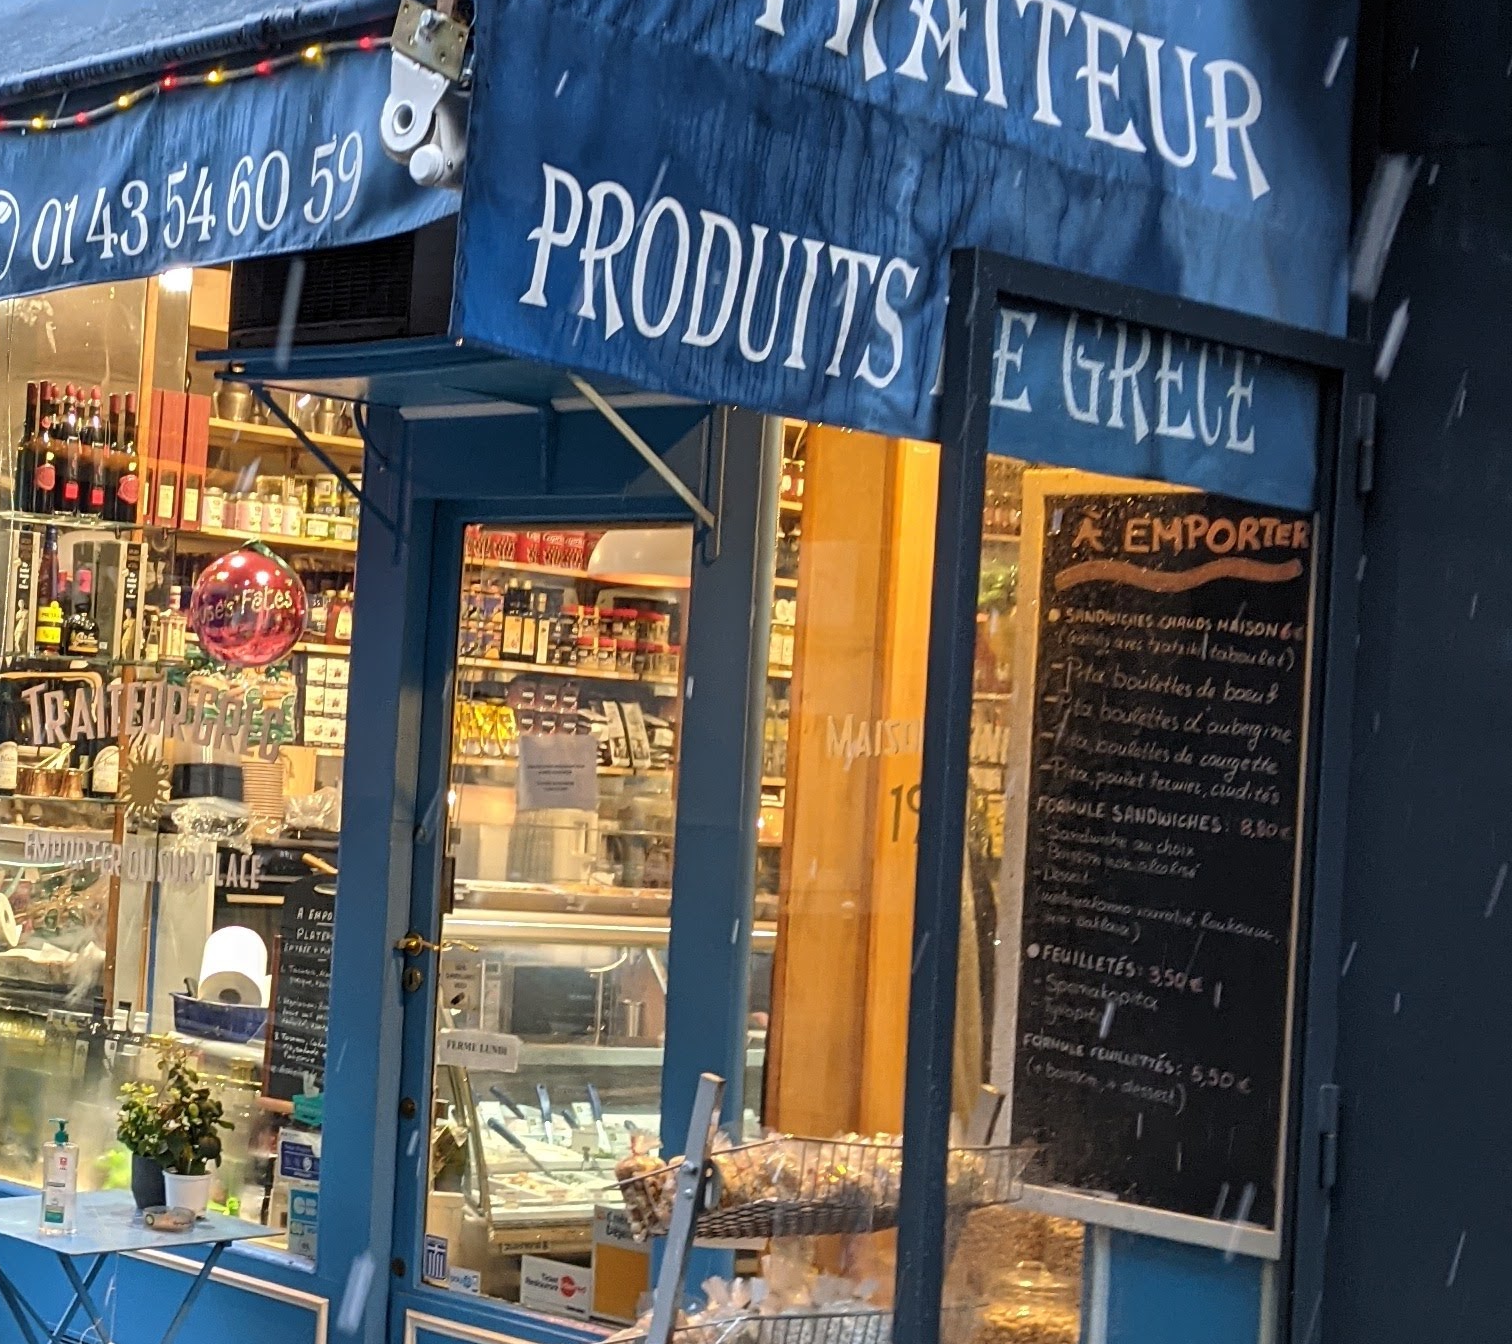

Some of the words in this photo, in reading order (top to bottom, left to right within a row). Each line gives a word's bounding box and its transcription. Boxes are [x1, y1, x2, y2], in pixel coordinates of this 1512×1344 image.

[518, 162, 920, 390] PRODUITS
[1123, 513, 1310, 554] EMPORTER
[22, 681, 188, 746] TRAITEUR
